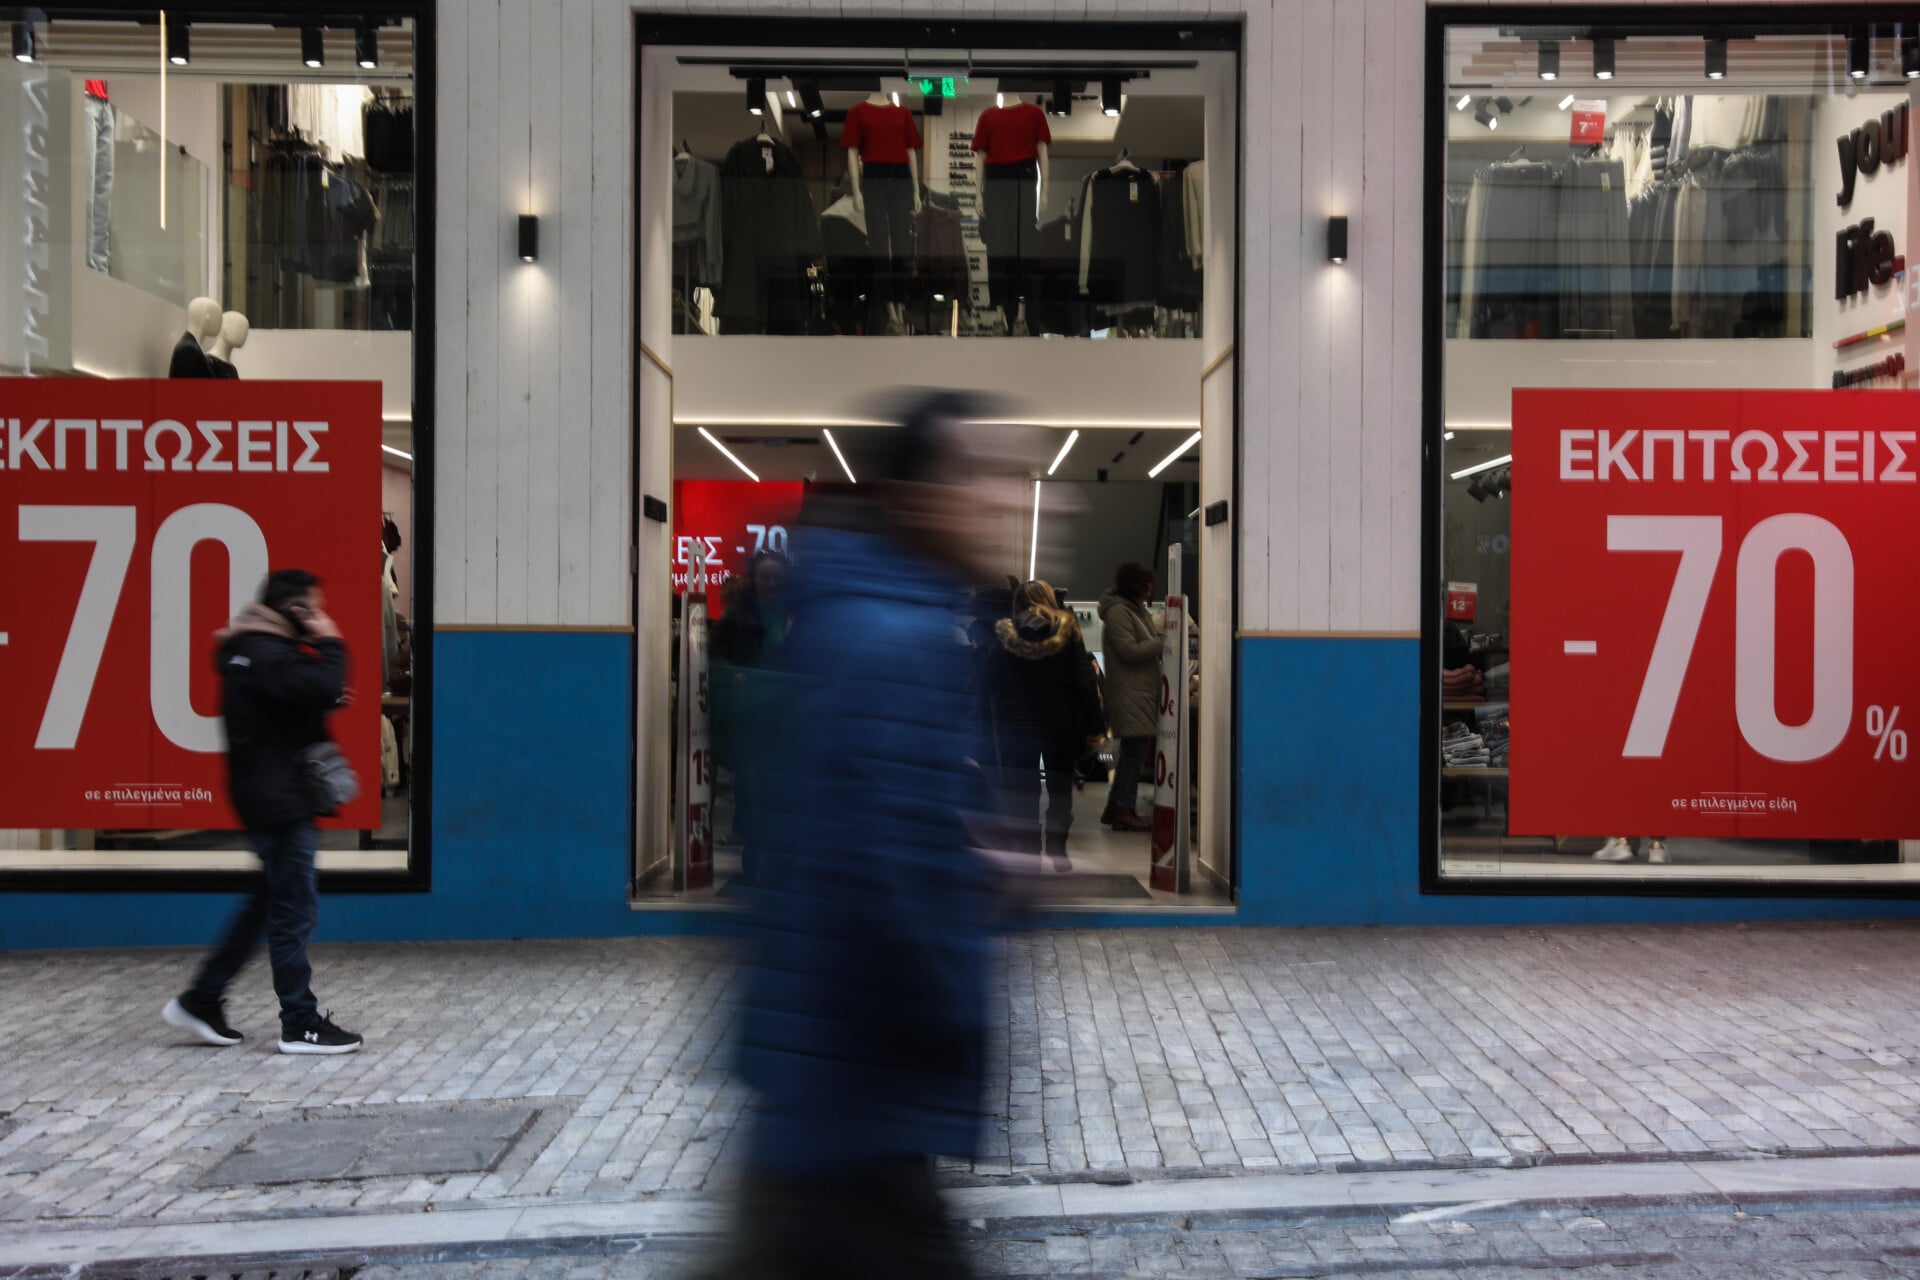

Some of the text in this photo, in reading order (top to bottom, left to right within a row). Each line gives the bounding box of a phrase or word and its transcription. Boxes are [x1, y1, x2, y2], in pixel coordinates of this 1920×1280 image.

[0, 418, 330, 472] ΚΠΤΩΣΕΙΣ
[1559, 429, 1918, 483] ΕΚΠΤΩΣΕΙΣ
[0, 502, 269, 753] 70
[84, 787, 213, 803] σε επιλεγμένα είδη
[1671, 796, 1798, 814] σε επιλεγμένα είδη
